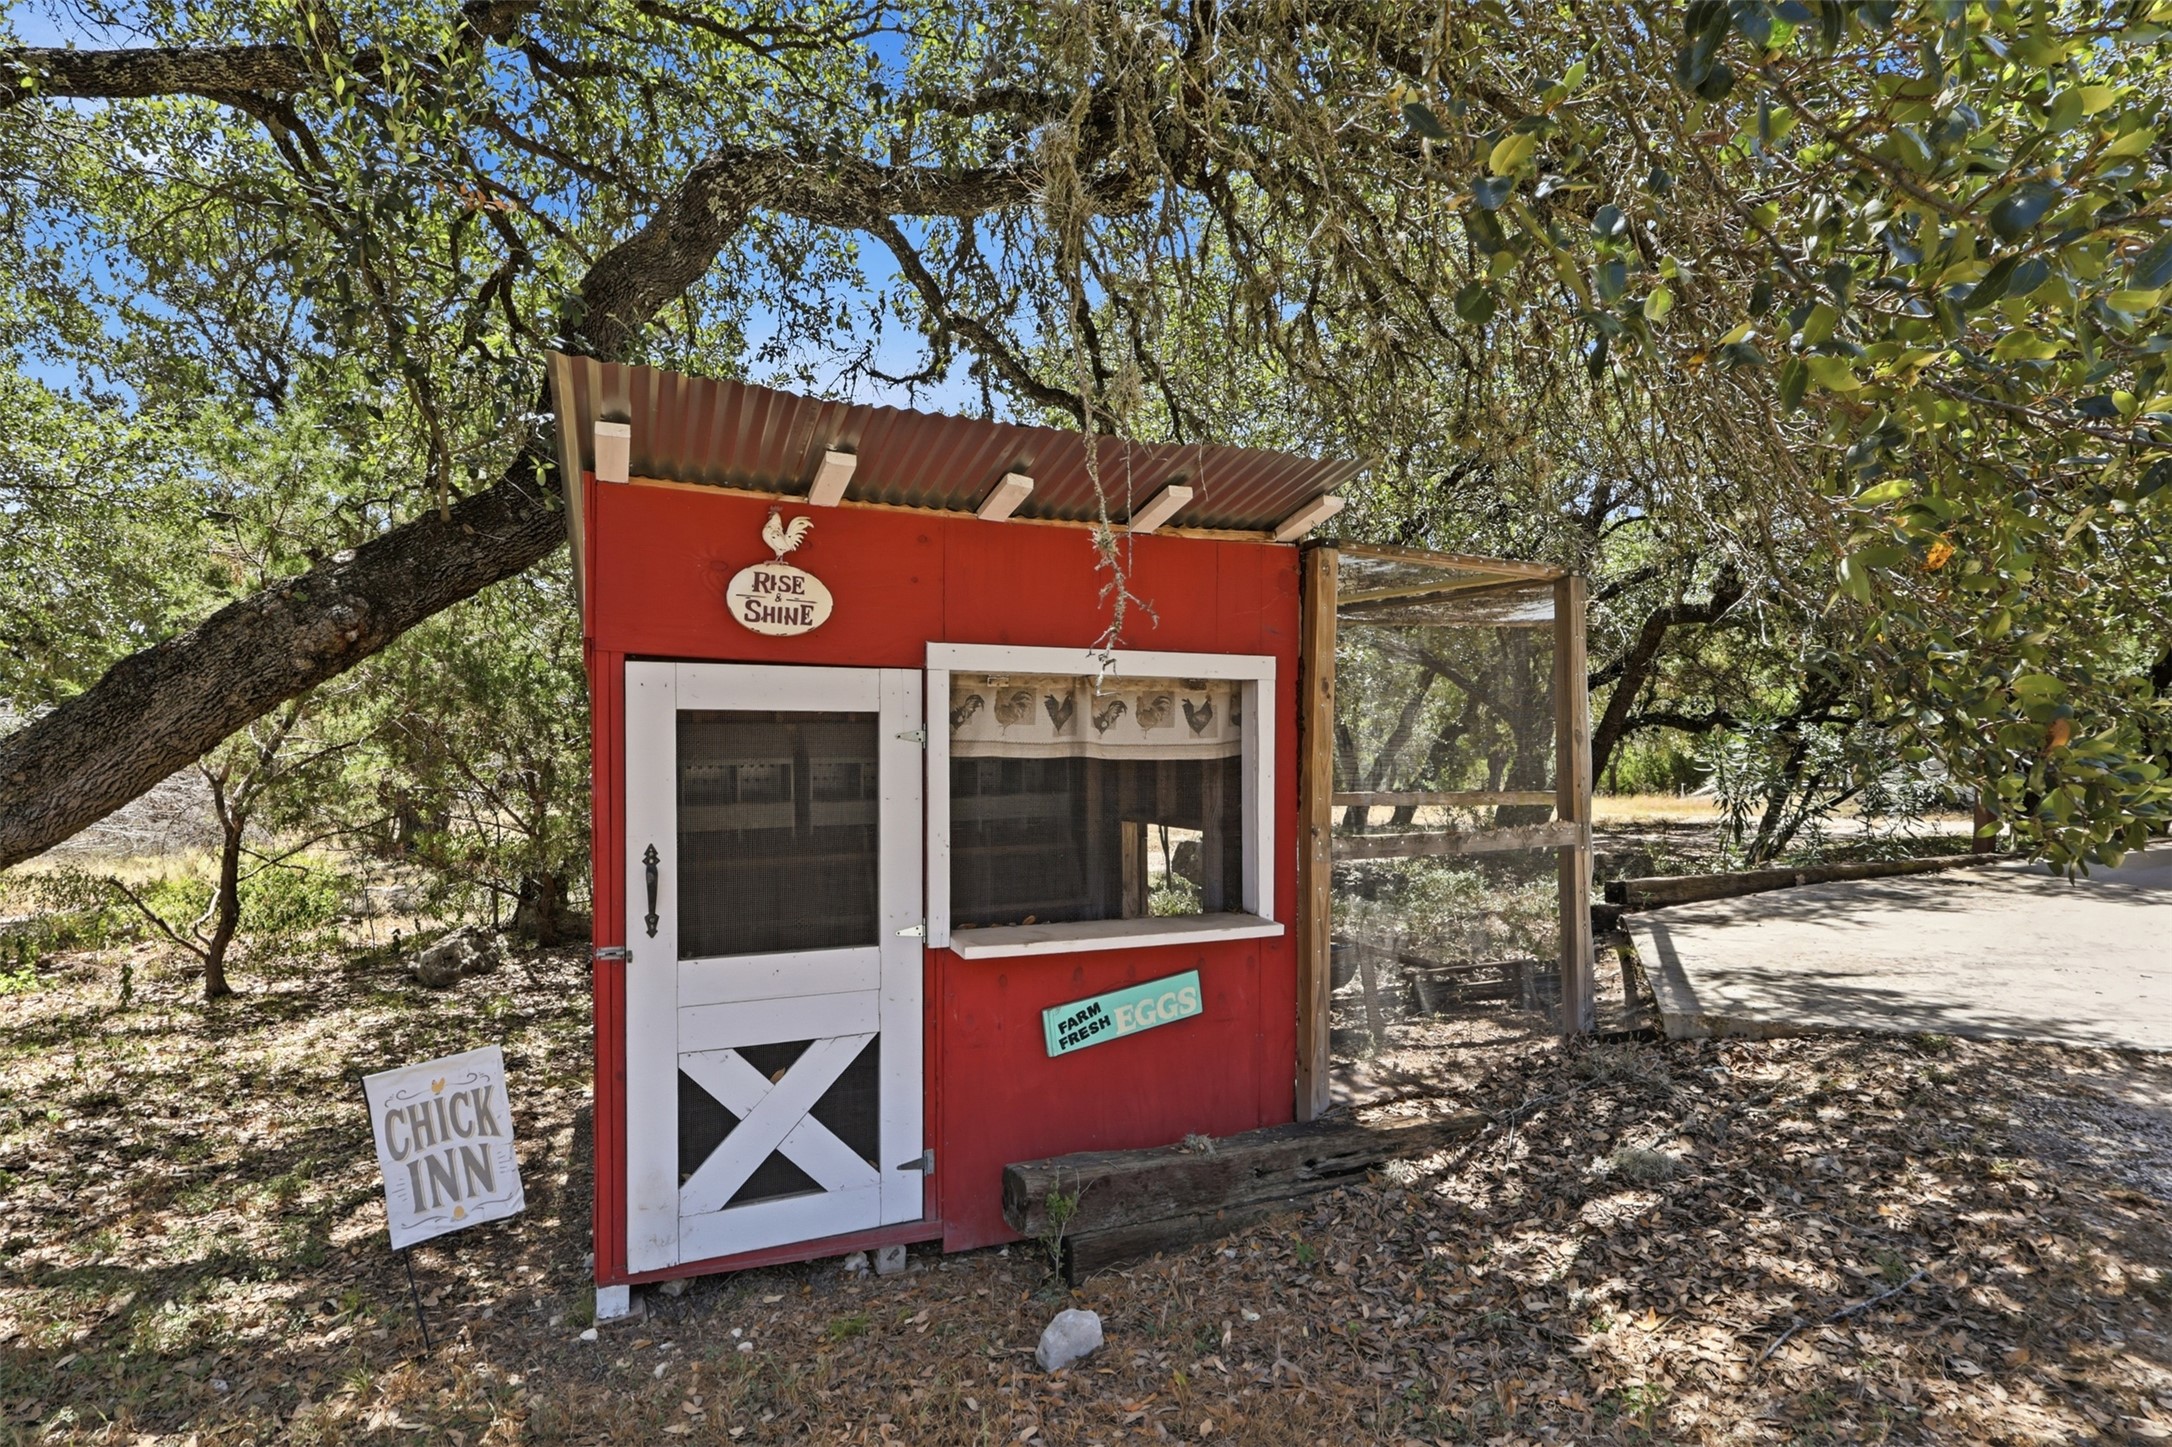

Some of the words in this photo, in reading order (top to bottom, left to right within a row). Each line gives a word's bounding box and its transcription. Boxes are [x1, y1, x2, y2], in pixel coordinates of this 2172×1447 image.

[752, 571, 805, 595] RISE
[774, 593, 781, 602] &
[744, 600, 814, 626] SHINE
[1058, 1002, 1101, 1035] FARM
[1114, 987, 1197, 1035] EGGS
[1058, 1015, 1111, 1050] FRESH
[384, 1084, 504, 1161] CHICK
[406, 1143, 497, 1214] INN
